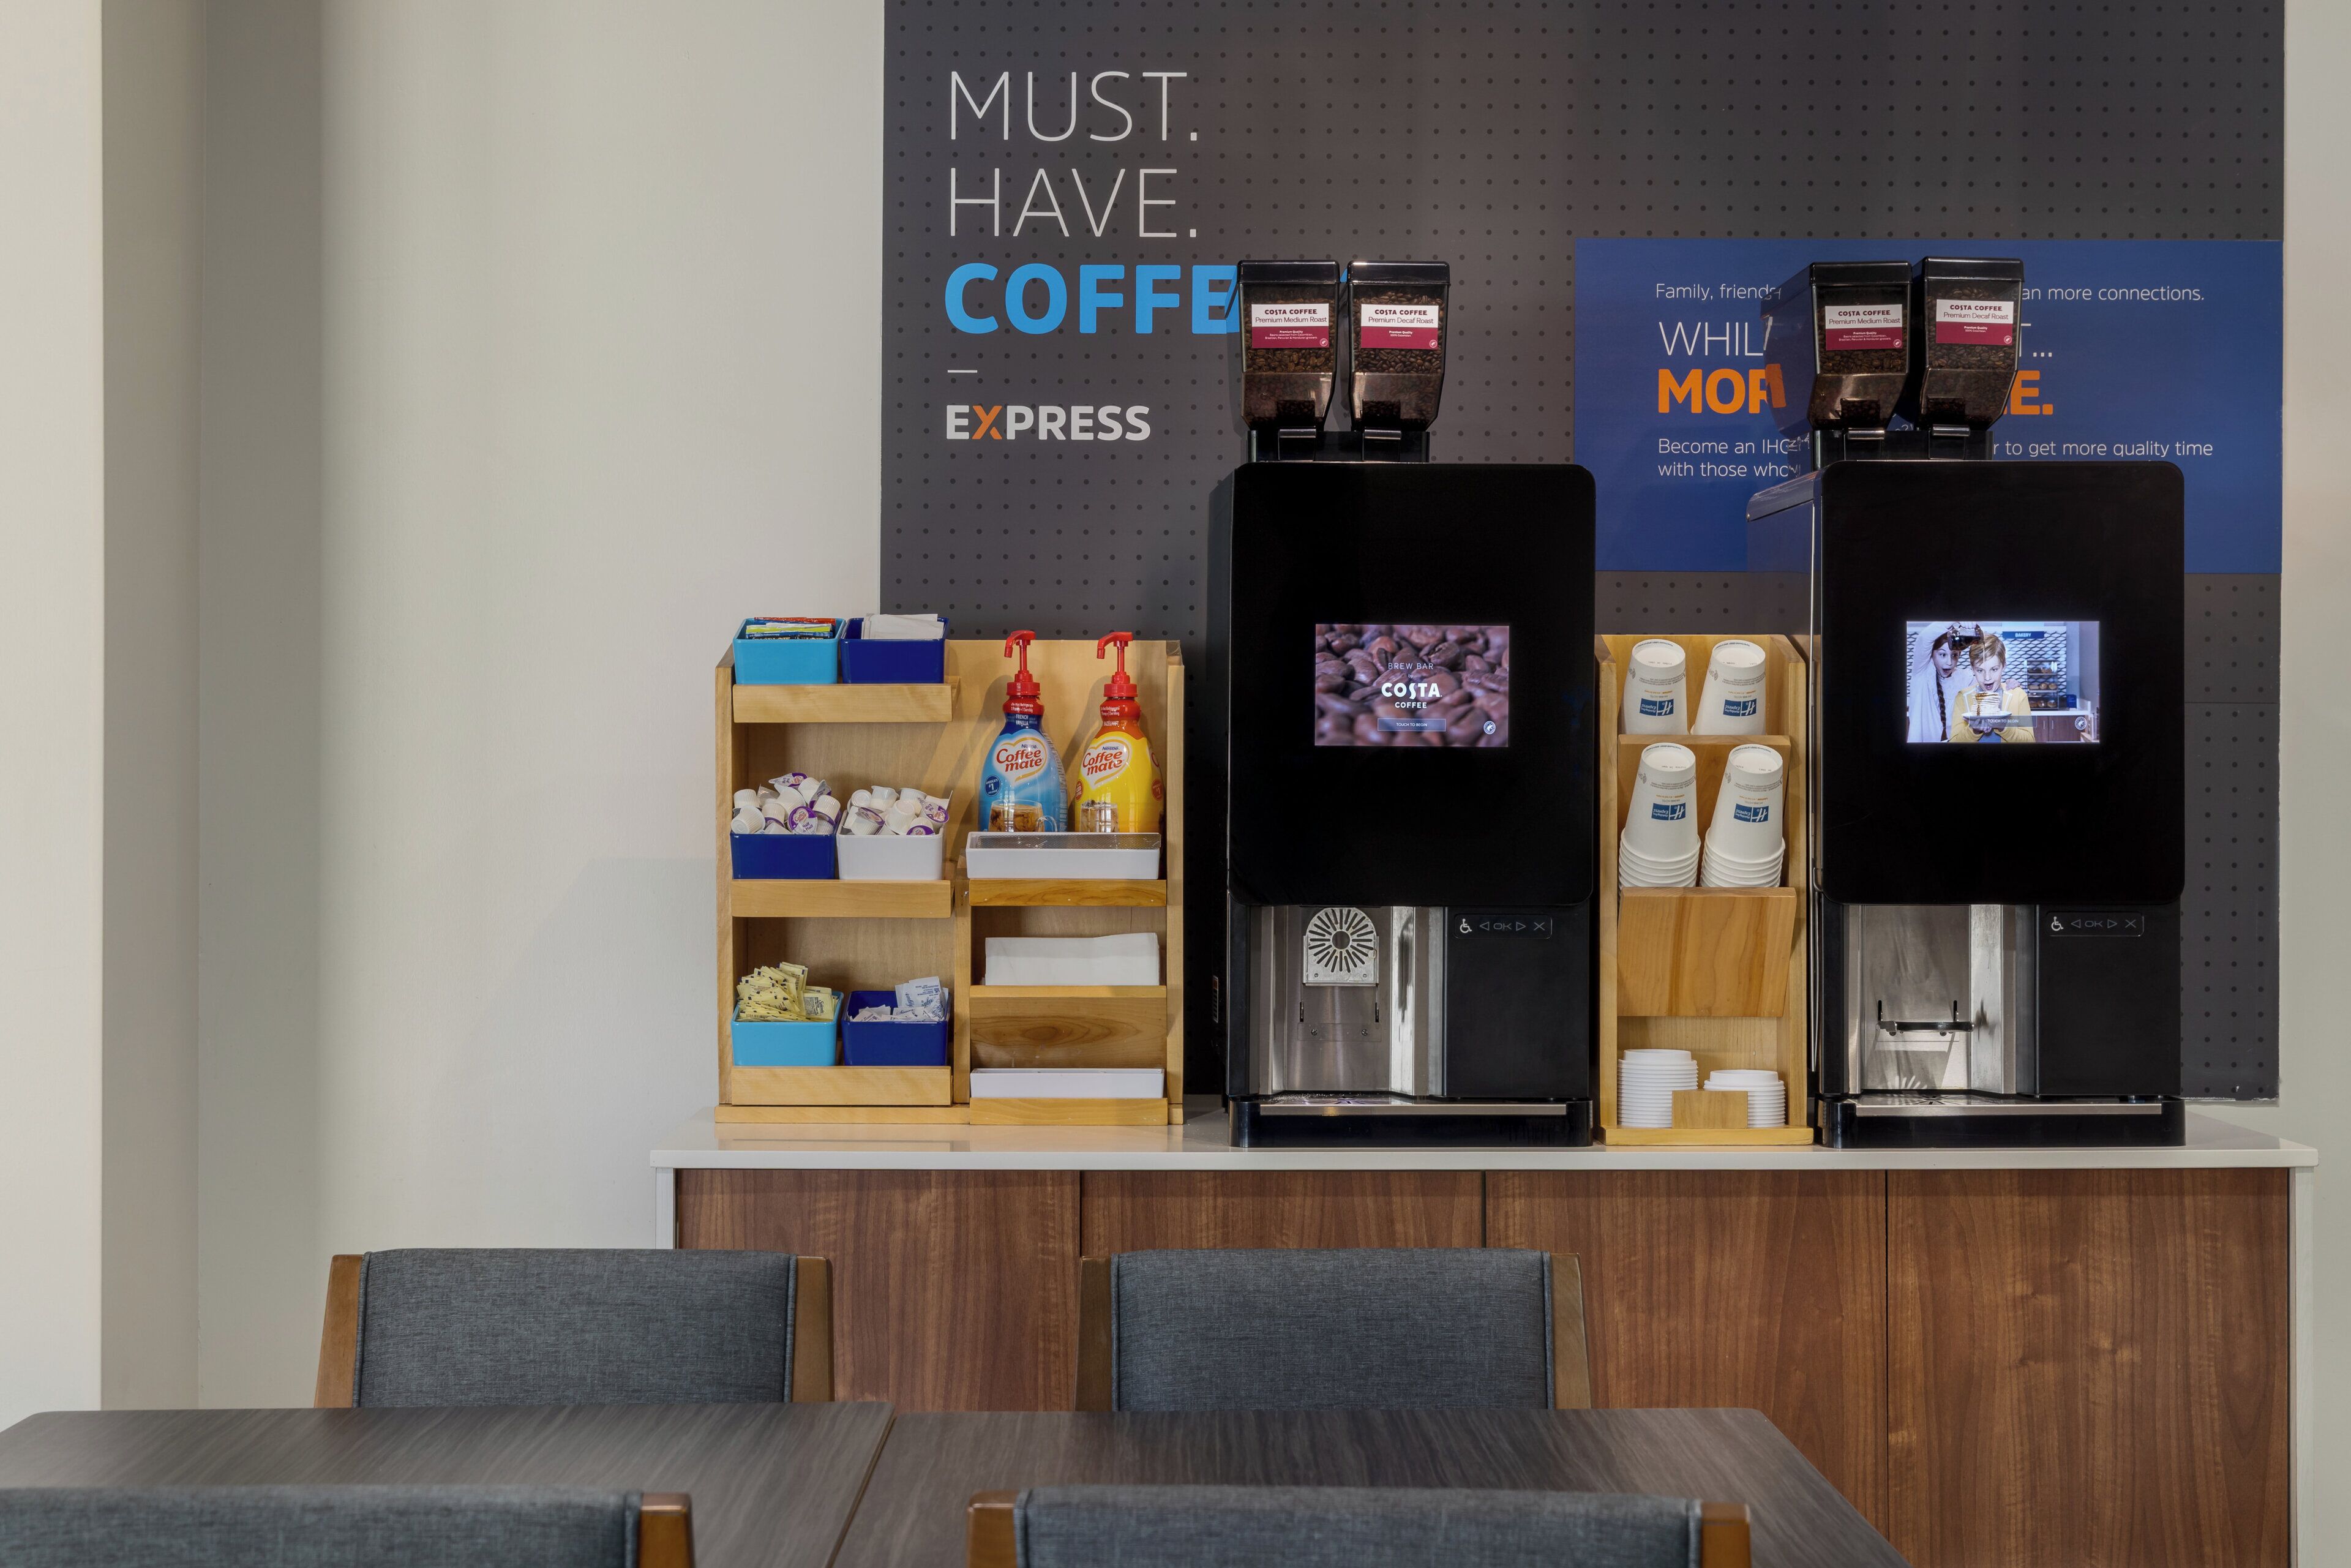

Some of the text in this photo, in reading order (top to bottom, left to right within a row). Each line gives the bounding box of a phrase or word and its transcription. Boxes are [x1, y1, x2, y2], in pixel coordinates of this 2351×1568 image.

[950, 70, 1198, 141] MUST.
[950, 168, 1197, 238] HAVE.
[1655, 283, 1714, 301] Family,
[2048, 288, 2092, 300] more
[2098, 286, 2205, 301] connections.
[1659, 321, 1763, 356] WHIL
[2003, 370, 2053, 415] E.
[947, 405, 1150, 441] EXPRESS
[1659, 438, 1728, 454] Become
[1734, 442, 1755, 454] an
[2005, 441, 2022, 455] to
[2028, 441, 2056, 457] get
[2063, 442, 2107, 456] more
[2113, 441, 2169, 457] quality
[2175, 441, 2213, 456] time
[1658, 462, 1693, 476] with
[1700, 462, 1747, 477] those
[1381, 683, 1441, 699] COSTA
[997, 748, 1041, 763] Coffee
[1082, 751, 1122, 768] Coffee
[1005, 758, 1042, 772] mate
[1087, 759, 1122, 776] mate
